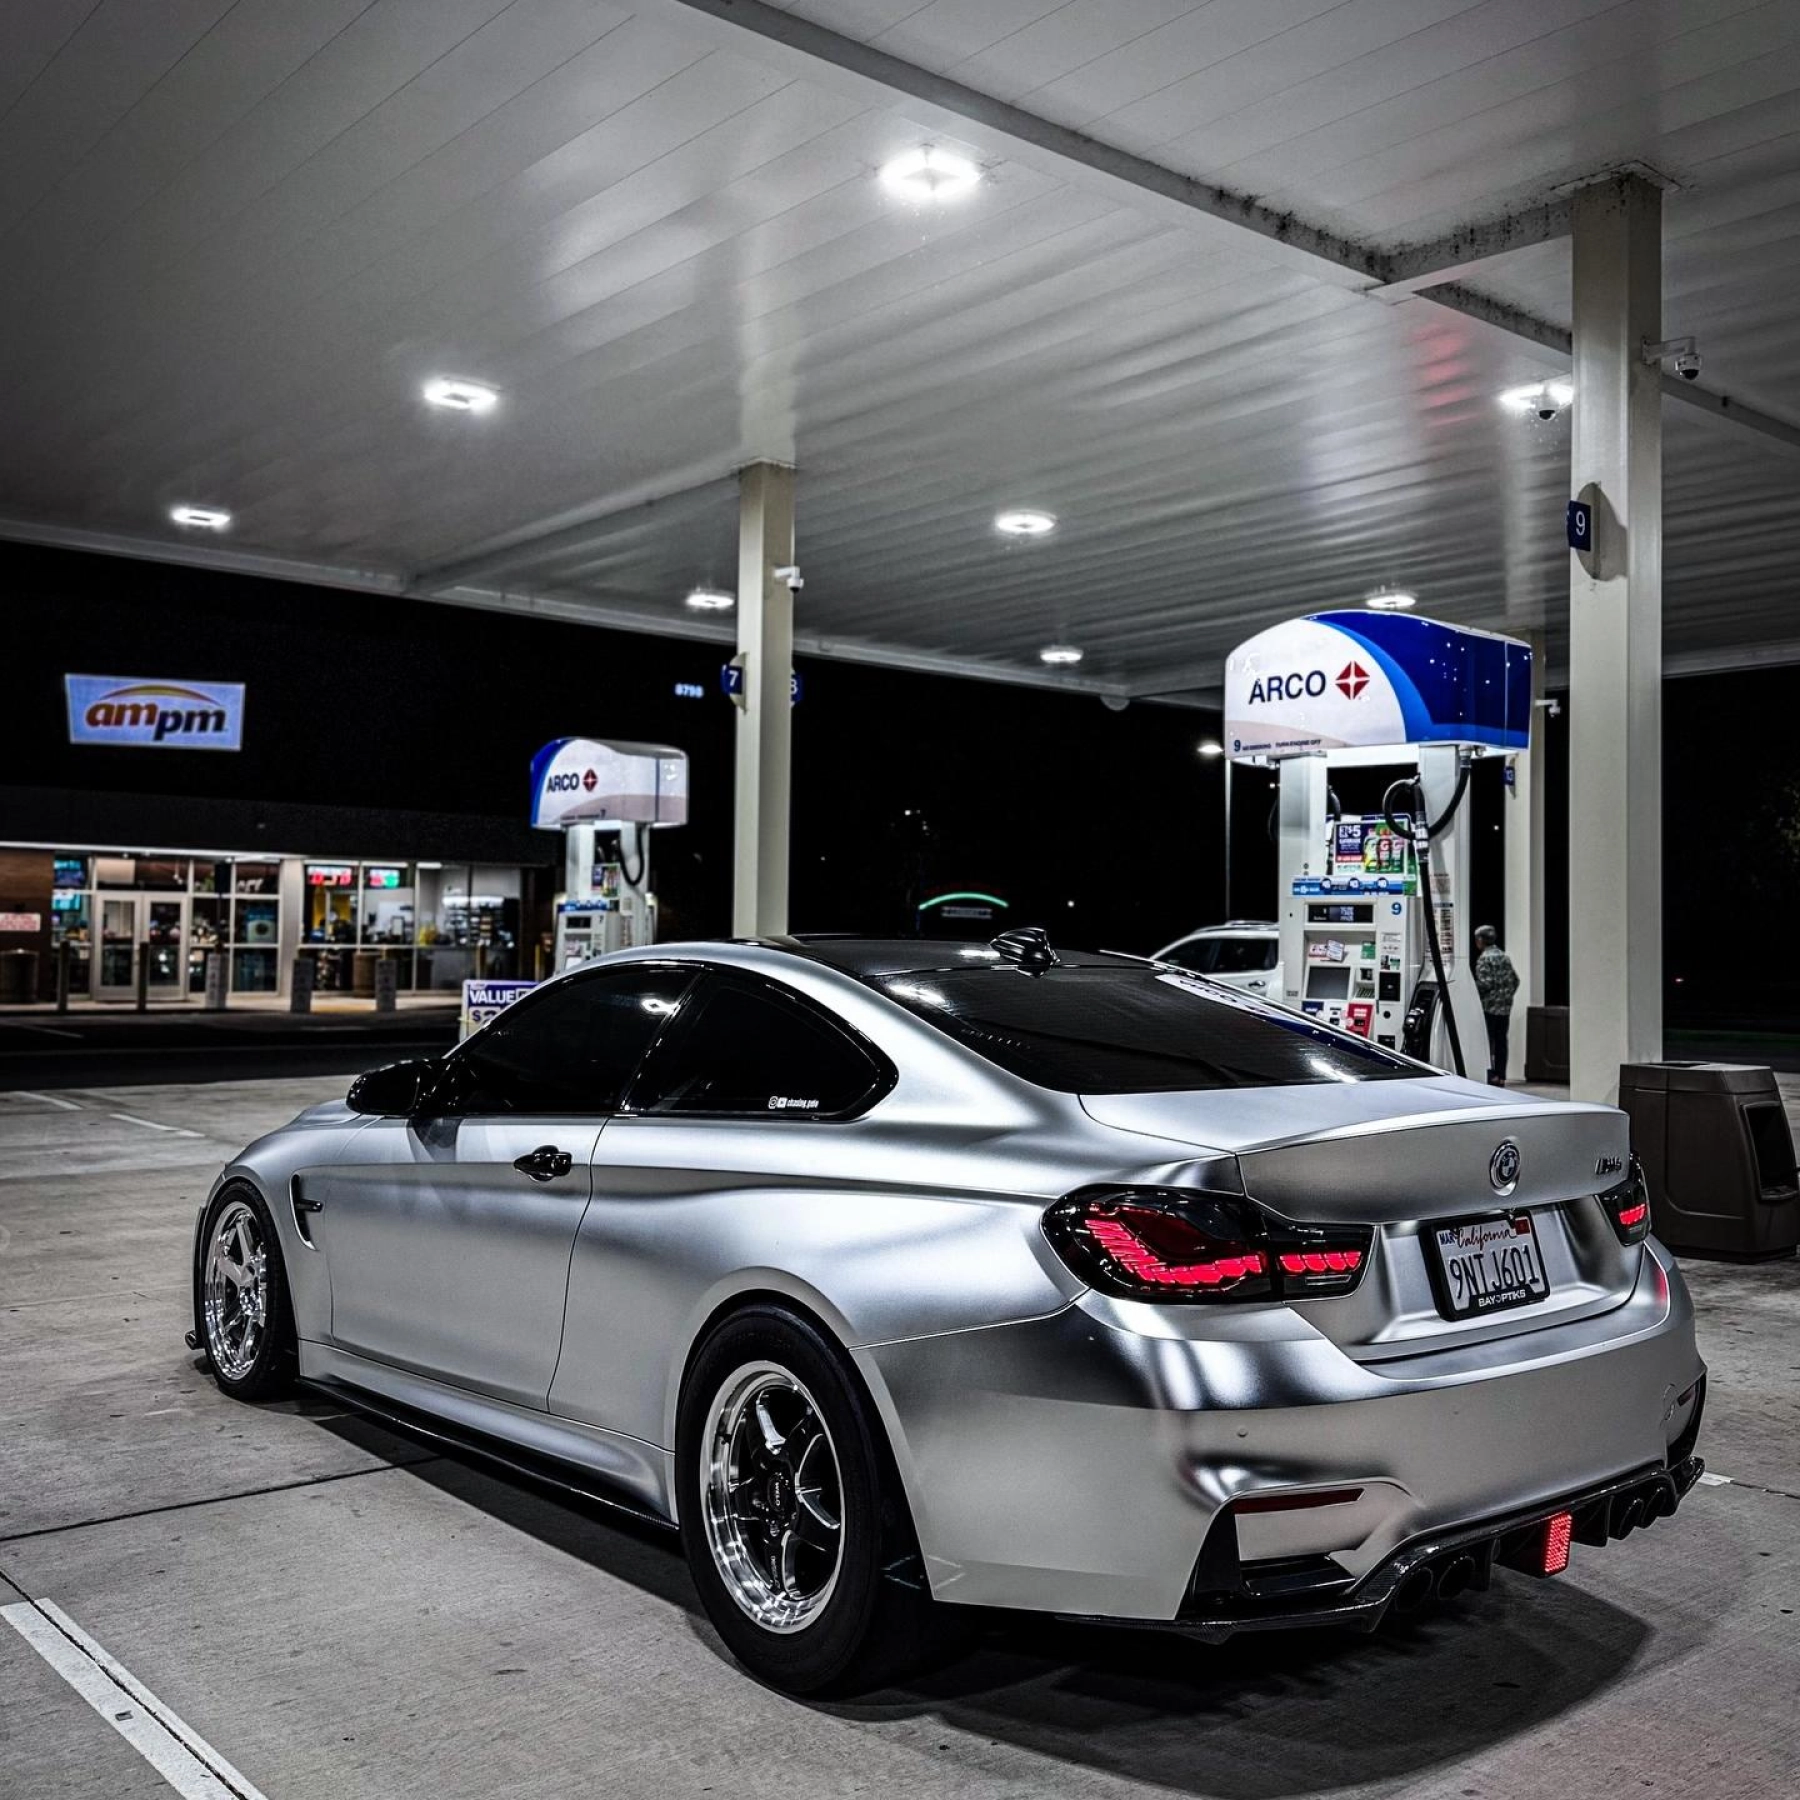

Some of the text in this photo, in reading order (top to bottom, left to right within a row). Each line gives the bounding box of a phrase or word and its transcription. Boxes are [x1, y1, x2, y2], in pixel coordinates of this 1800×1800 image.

[1576, 511, 1585, 535] 9
[729, 670, 739, 687] 7
[1249, 670, 1327, 705] ARCO
[85, 702, 227, 741] ampm
[1234, 740, 1241, 752] 9
[546, 773, 580, 792] ARCO
[1391, 902, 1402, 915] 9
[469, 989, 515, 1004] VALUE
[1457, 1225, 1517, 1250] California
[1449, 1245, 1540, 1300] 9NTJ601
